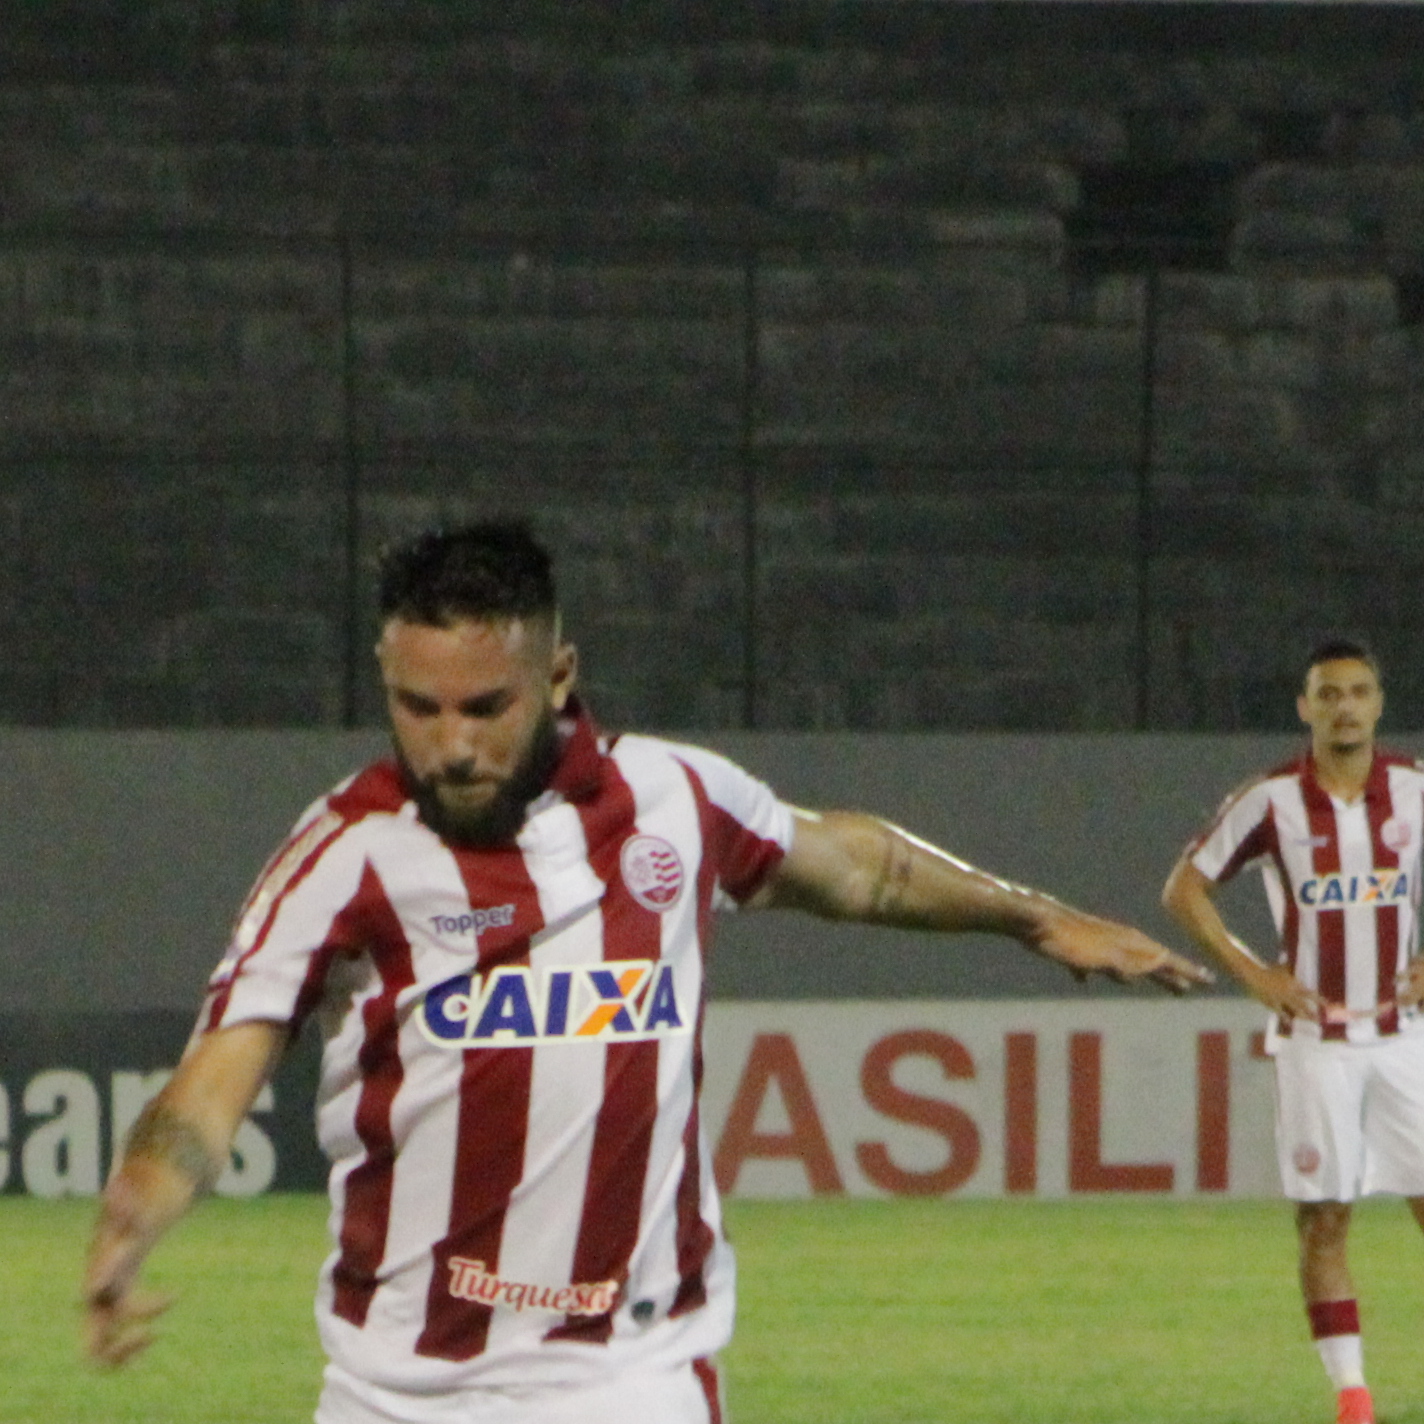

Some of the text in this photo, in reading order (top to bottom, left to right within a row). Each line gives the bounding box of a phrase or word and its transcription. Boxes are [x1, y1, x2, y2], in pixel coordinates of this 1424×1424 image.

[1299, 872, 1408, 905] CAIXA
[428, 903, 516, 935] Topper
[424, 964, 684, 1040] CAIXA
[714, 1028, 1278, 1196] ASILI
[450, 1257, 617, 1315] Turquesa
